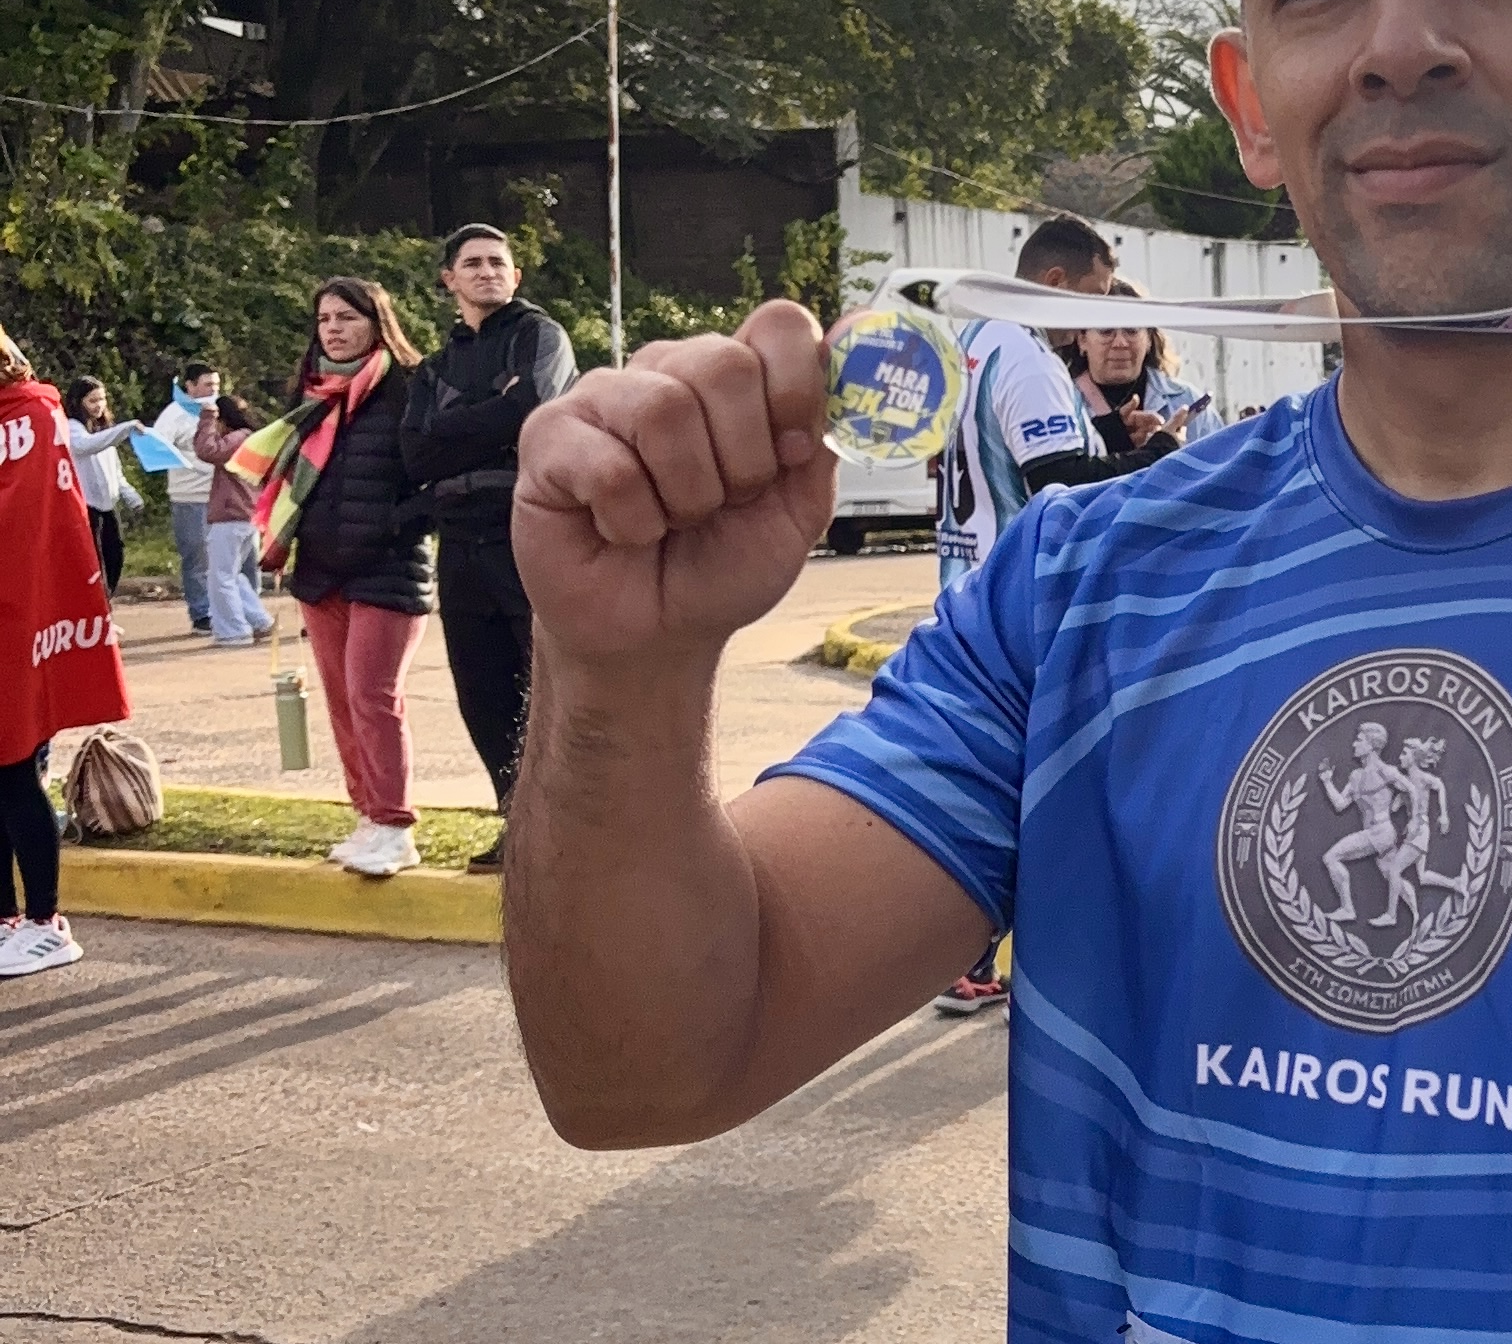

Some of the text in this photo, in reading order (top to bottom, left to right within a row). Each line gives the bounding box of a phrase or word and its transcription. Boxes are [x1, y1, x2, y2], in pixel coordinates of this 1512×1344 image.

[873, 361, 931, 395] MARA
[886, 386, 927, 414] TON
[1297, 666, 1505, 741] KAIROS RUN
[1195, 1043, 1391, 1110] KAIROS
